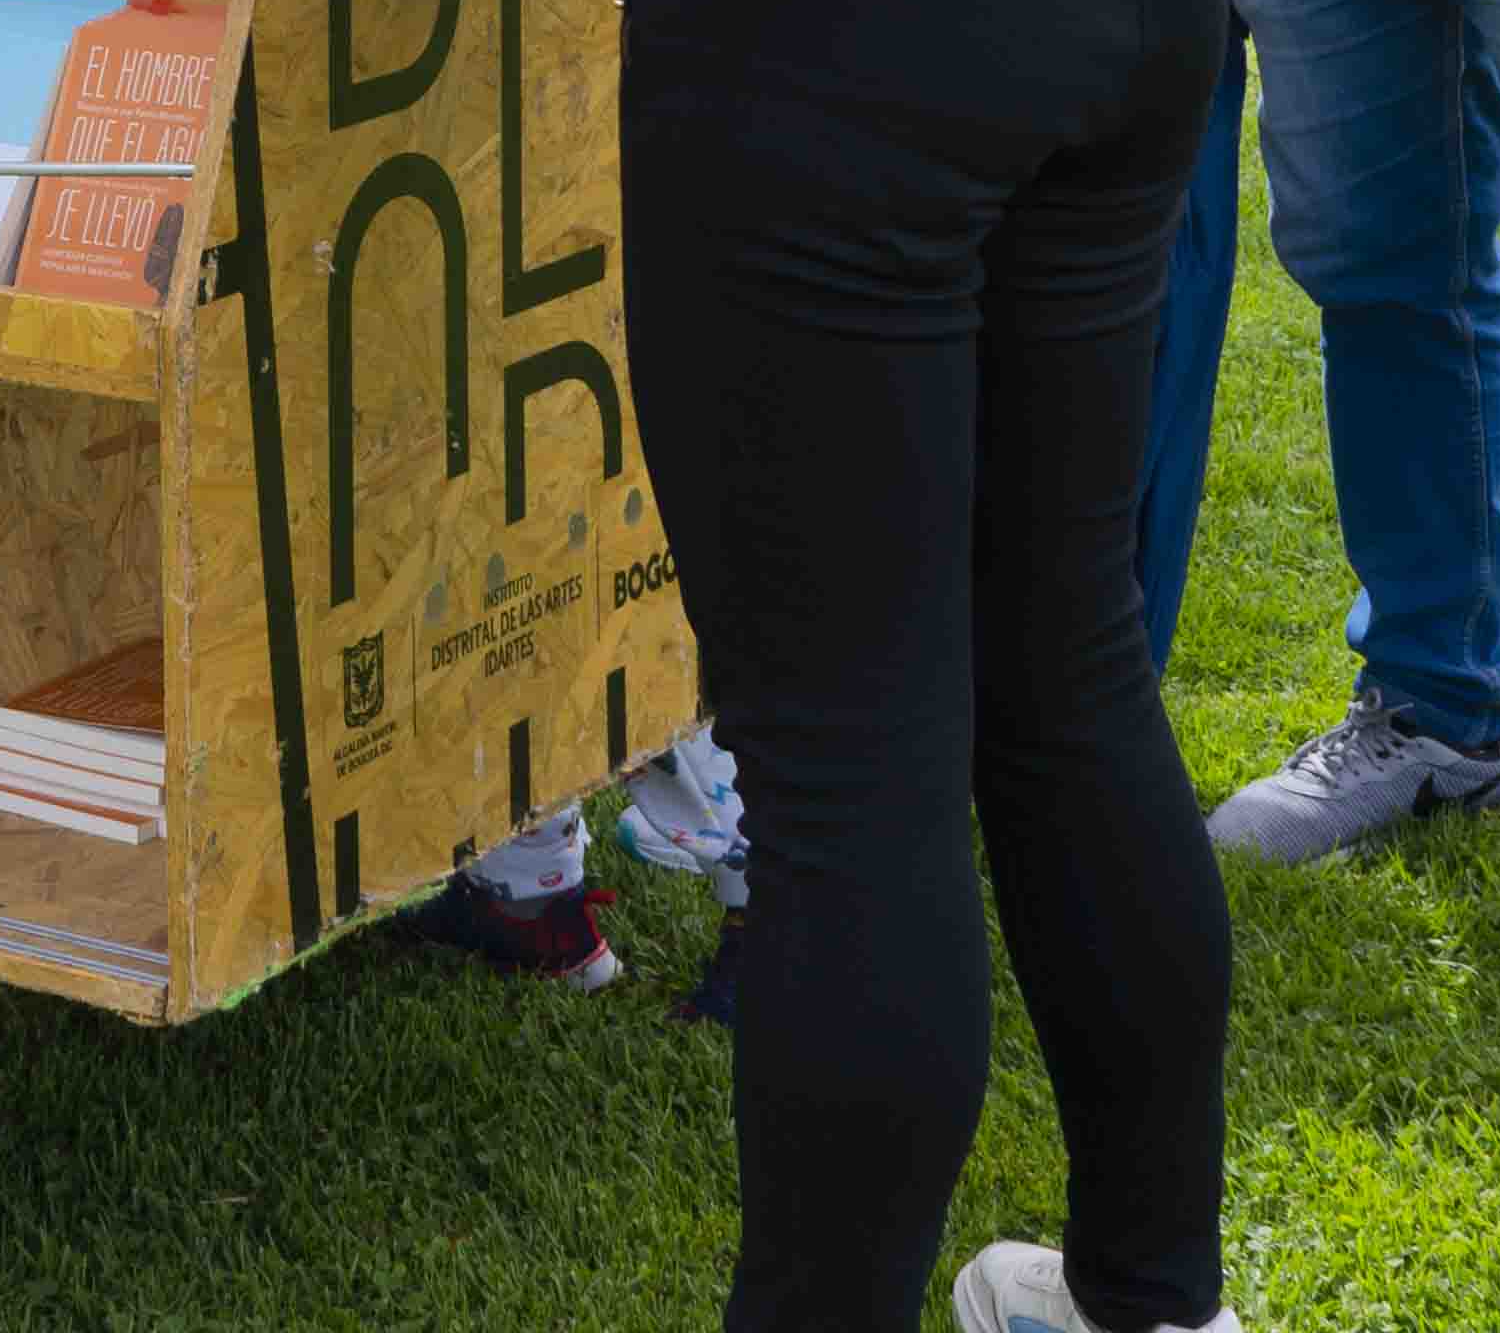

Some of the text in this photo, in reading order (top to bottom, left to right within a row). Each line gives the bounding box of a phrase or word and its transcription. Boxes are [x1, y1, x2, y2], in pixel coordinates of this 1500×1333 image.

[82, 45, 217, 110] EL HOMBRE
[46, 188, 81, 243] SE
[483, 572, 534, 613] INSTITUTO
[431, 573, 584, 672] DISTRITAL DE LAS ARTES
[484, 629, 535, 678] IDARTES
